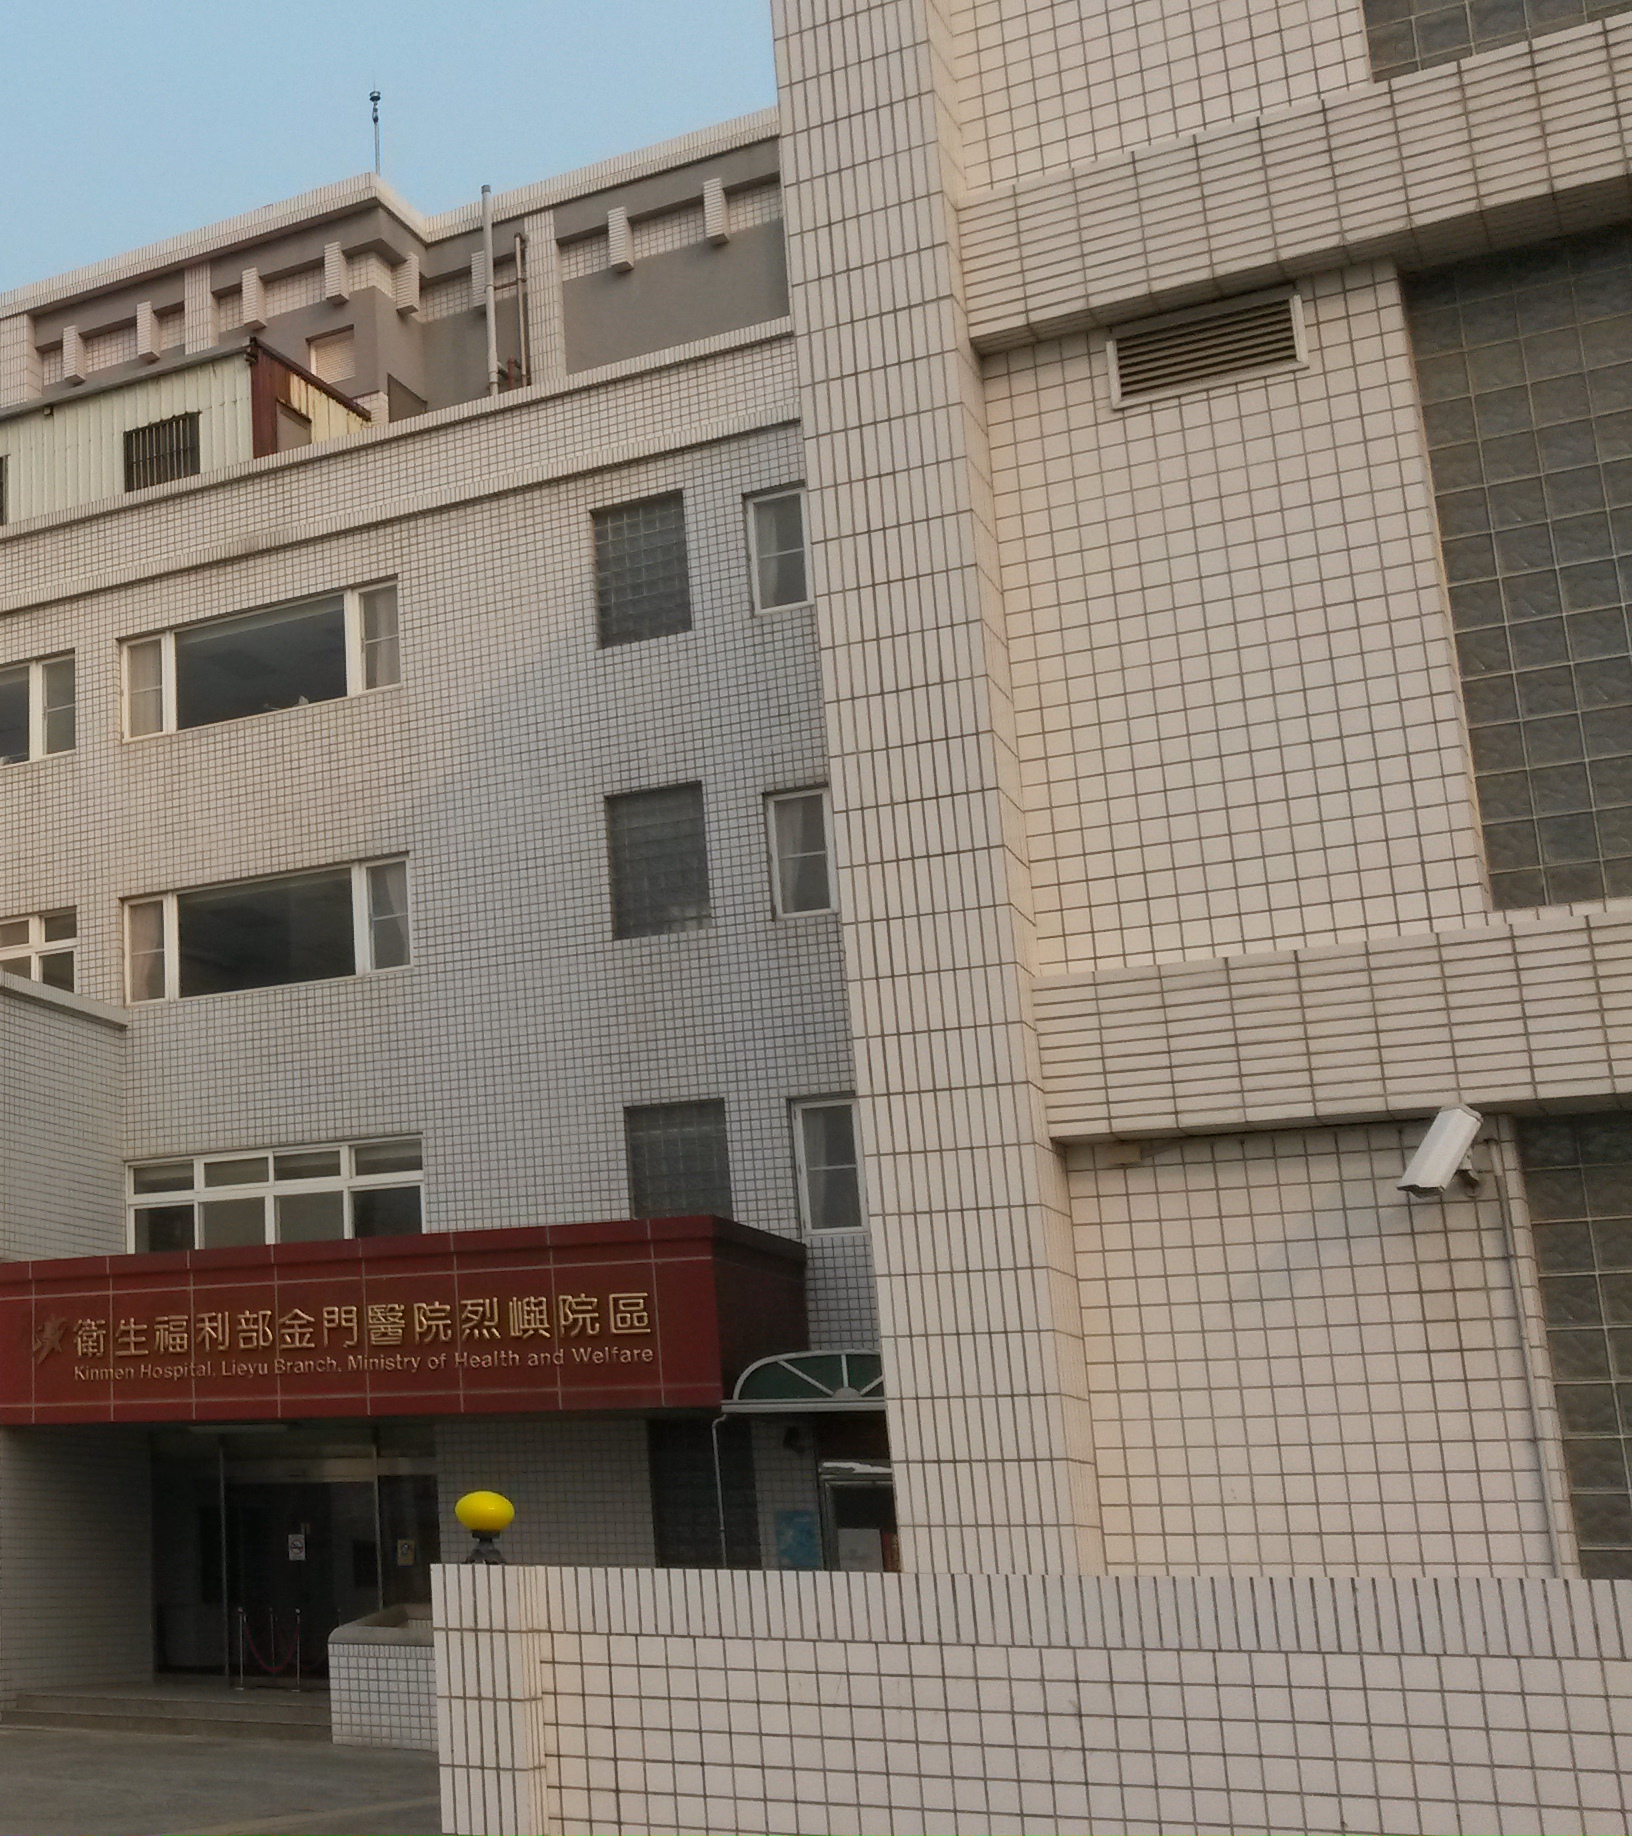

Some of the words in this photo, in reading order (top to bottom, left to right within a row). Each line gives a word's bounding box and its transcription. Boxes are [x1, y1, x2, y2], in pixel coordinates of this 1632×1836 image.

[73, 1292, 652, 1358] 衛生福利部金門醫院烈嶼院區
[73, 1364, 135, 1381] Kinmen
[221, 1358, 269, 1379] Lieyu
[347, 1350, 422, 1373] Ministry
[427, 1353, 447, 1370] of
[454, 1349, 520, 1369] Health
[526, 1349, 565, 1367] and
[572, 1346, 654, 1365] Welfare
